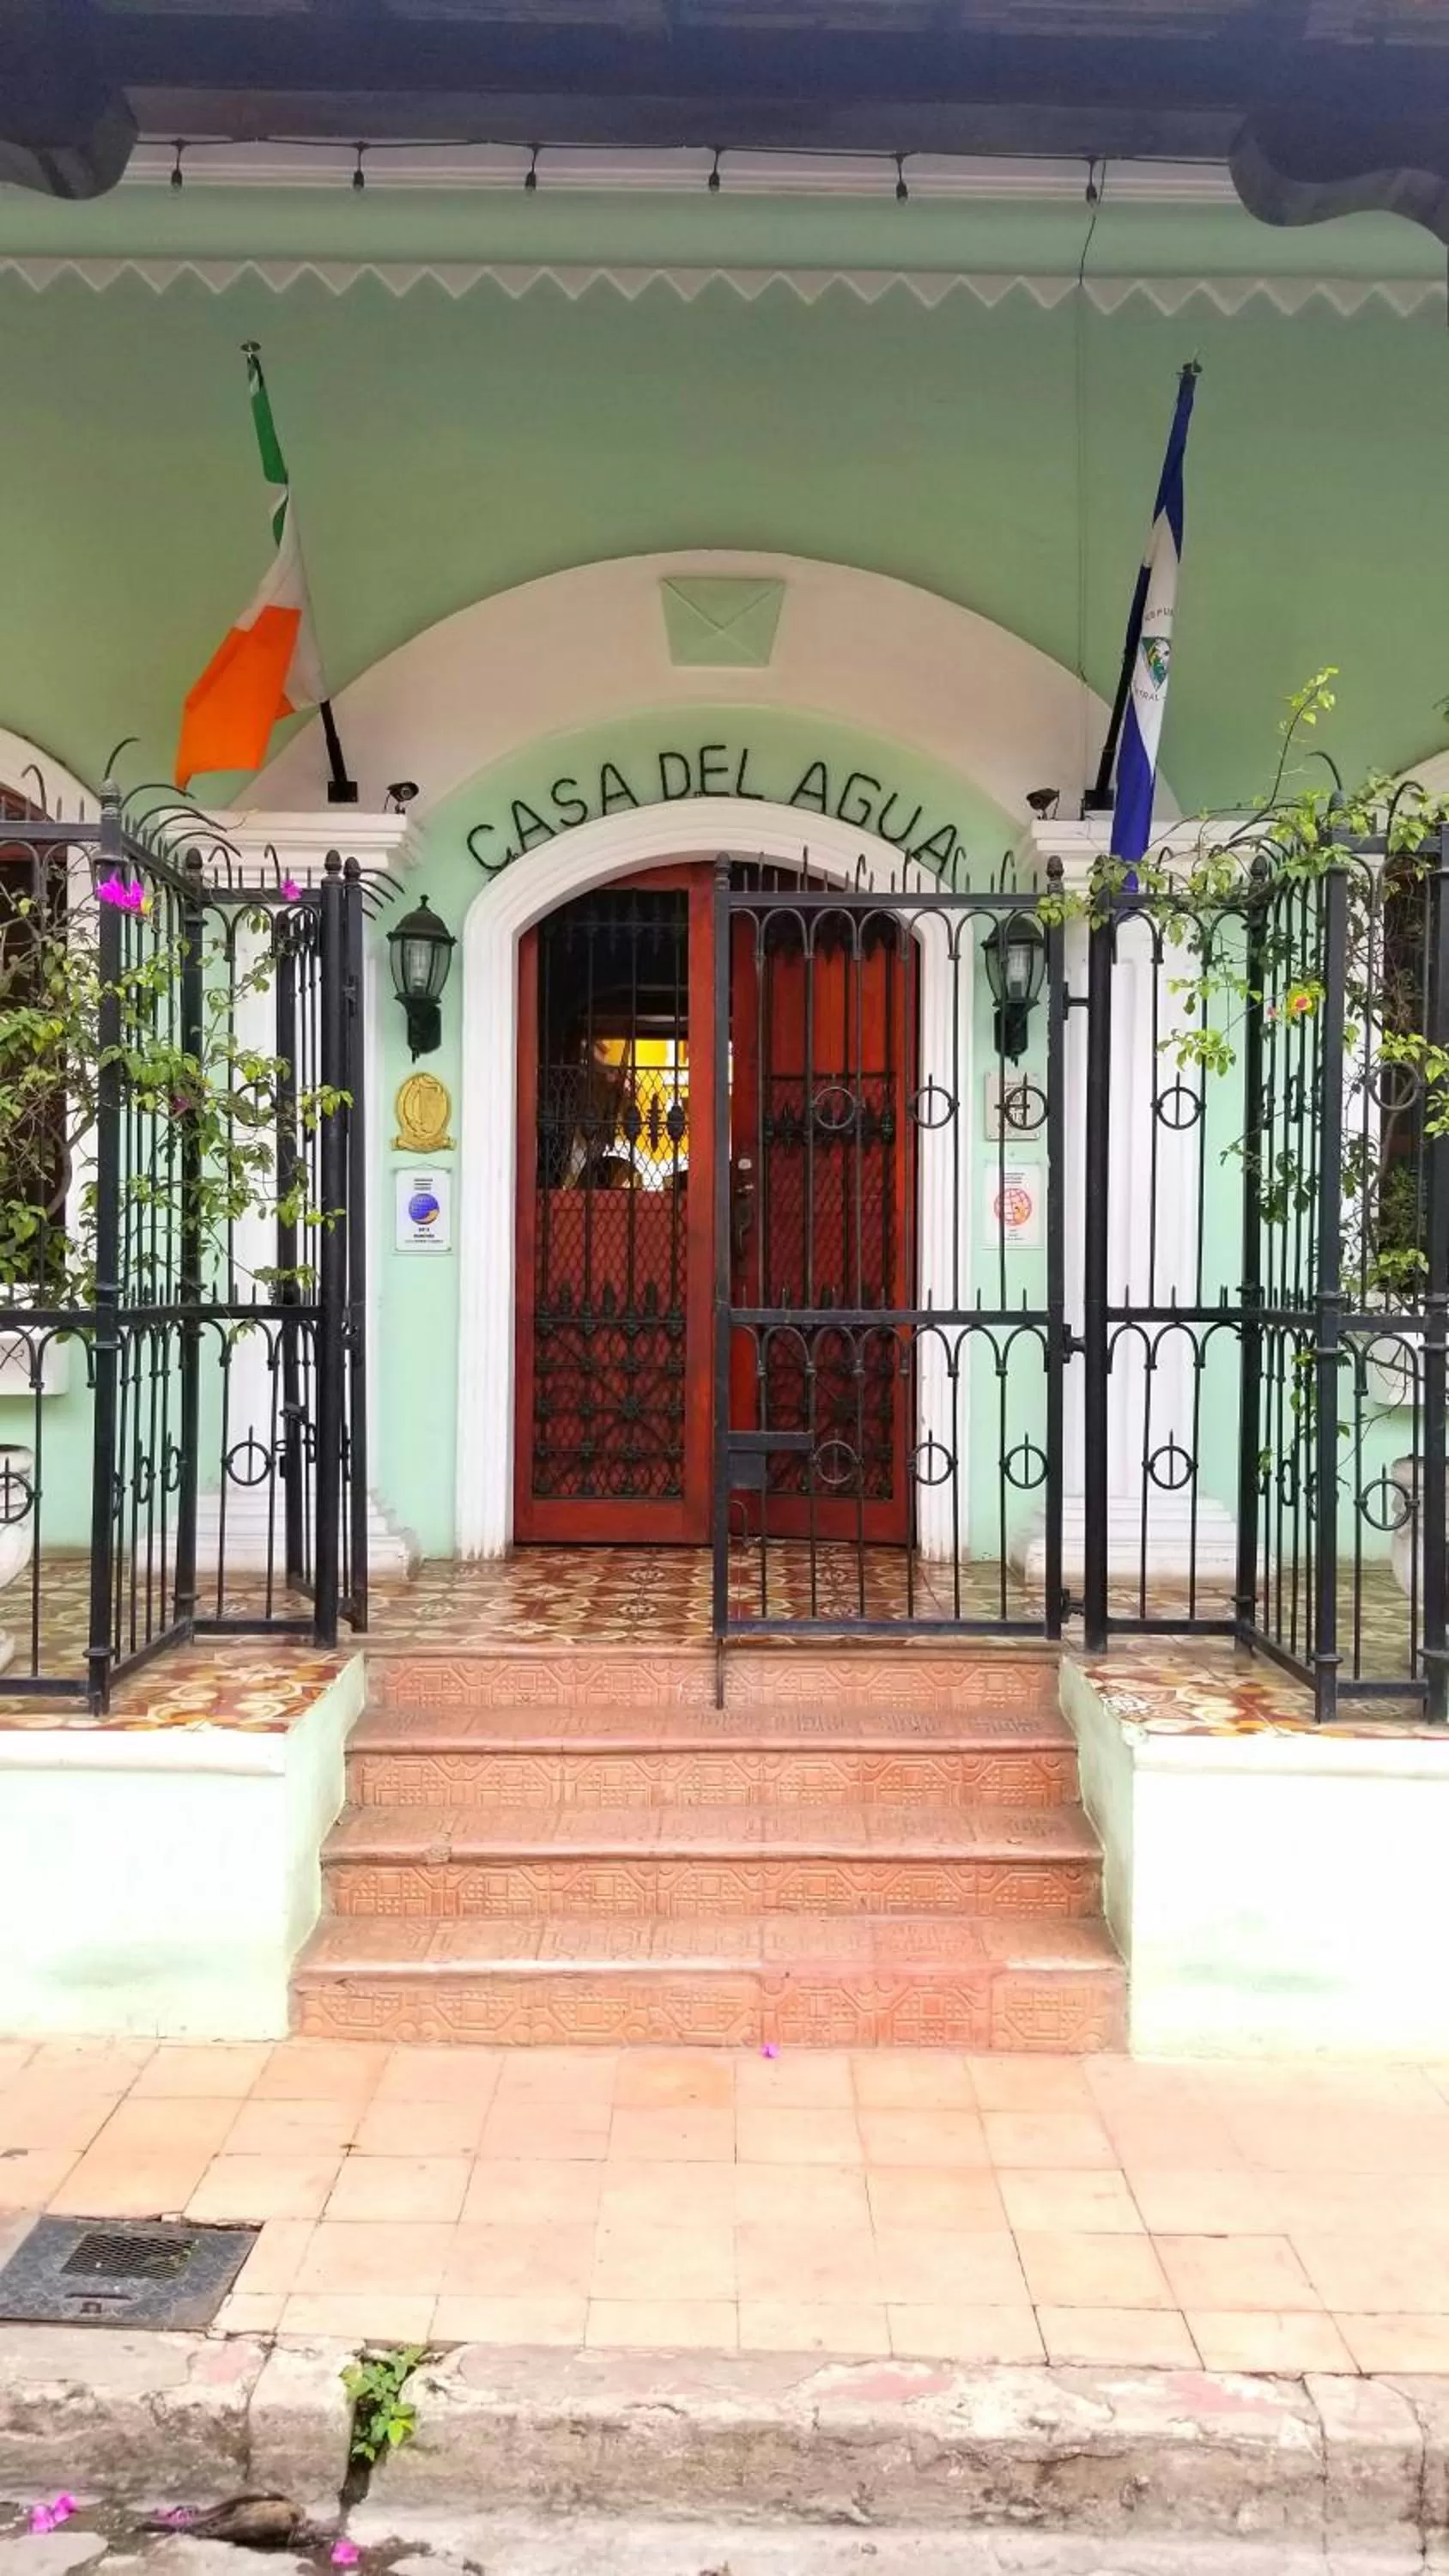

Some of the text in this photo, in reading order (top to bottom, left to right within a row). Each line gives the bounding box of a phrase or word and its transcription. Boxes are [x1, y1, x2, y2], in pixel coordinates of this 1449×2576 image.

[466, 744, 958, 876] CASA DEL AGUA
